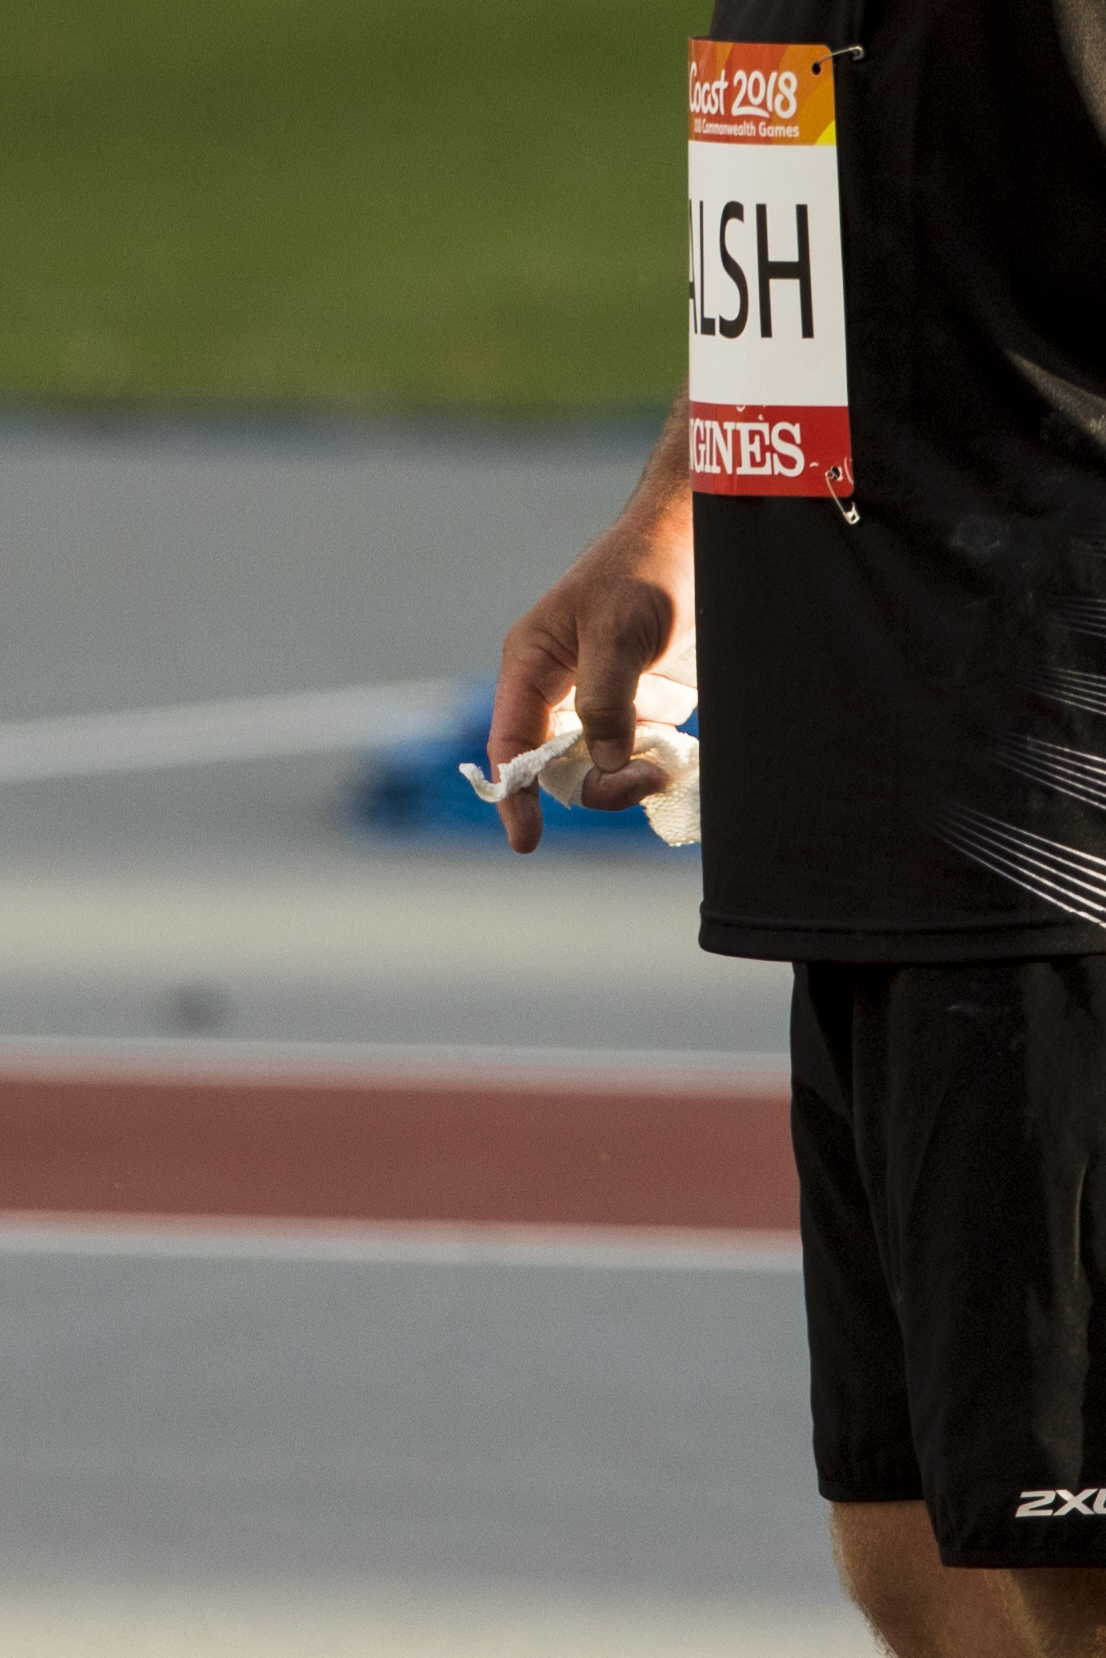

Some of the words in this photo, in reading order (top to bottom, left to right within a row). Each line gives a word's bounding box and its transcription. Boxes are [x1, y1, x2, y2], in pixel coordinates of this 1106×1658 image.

[689, 62, 729, 116] Coast
[731, 69, 798, 120] 2018
[758, 121, 800, 138] Games
[689, 418, 806, 478] GINES
